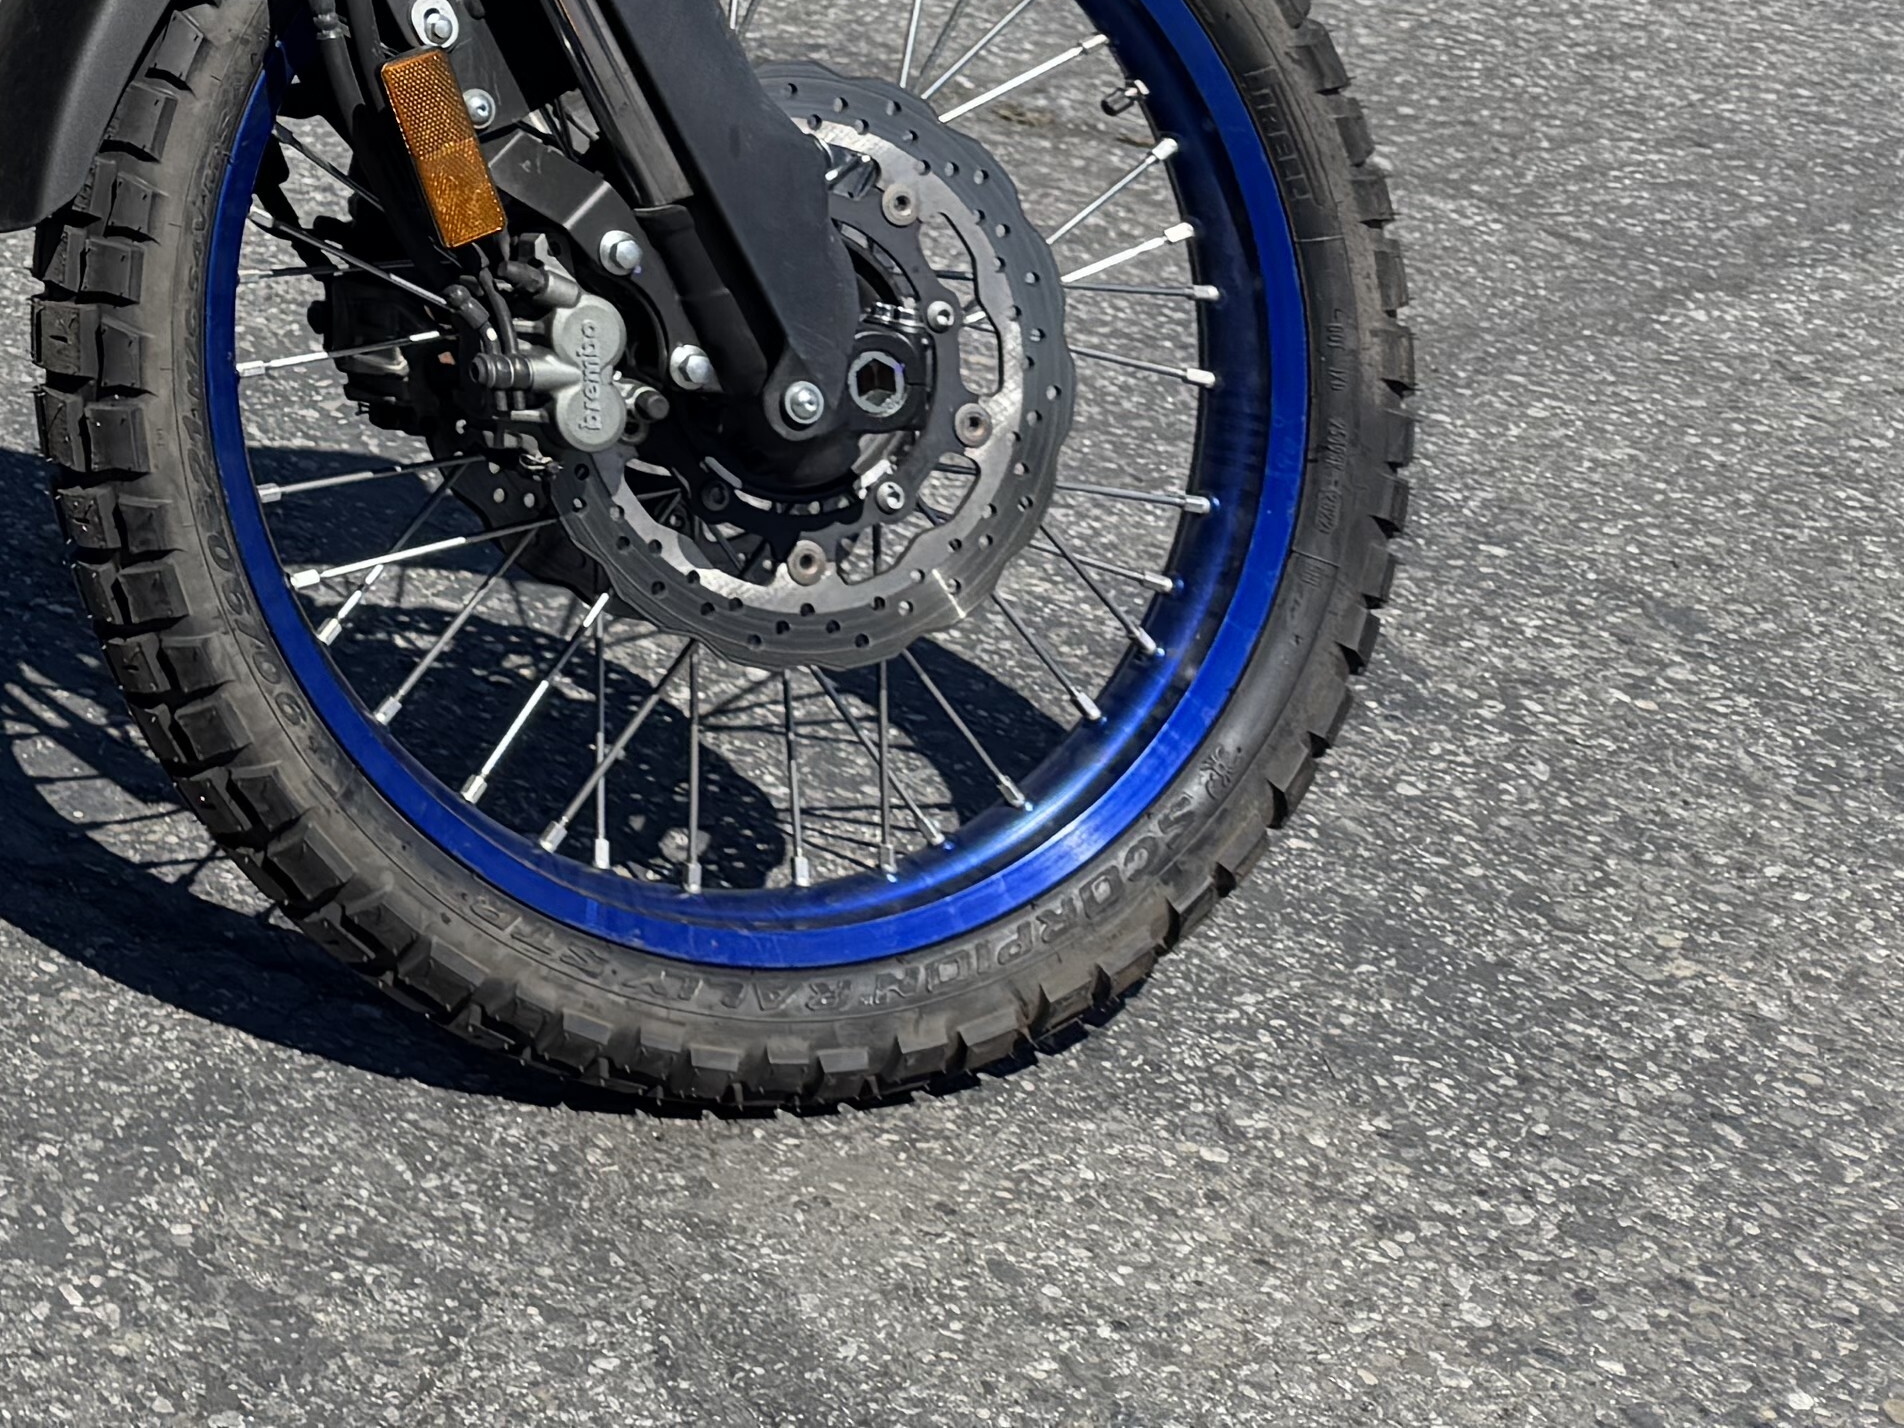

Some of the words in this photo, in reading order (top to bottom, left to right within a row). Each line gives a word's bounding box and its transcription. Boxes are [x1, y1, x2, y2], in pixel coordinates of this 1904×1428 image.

[576, 319, 602, 431] brembo
[464, 888, 609, 980] STR
[619, 960, 855, 1011] RALLY
